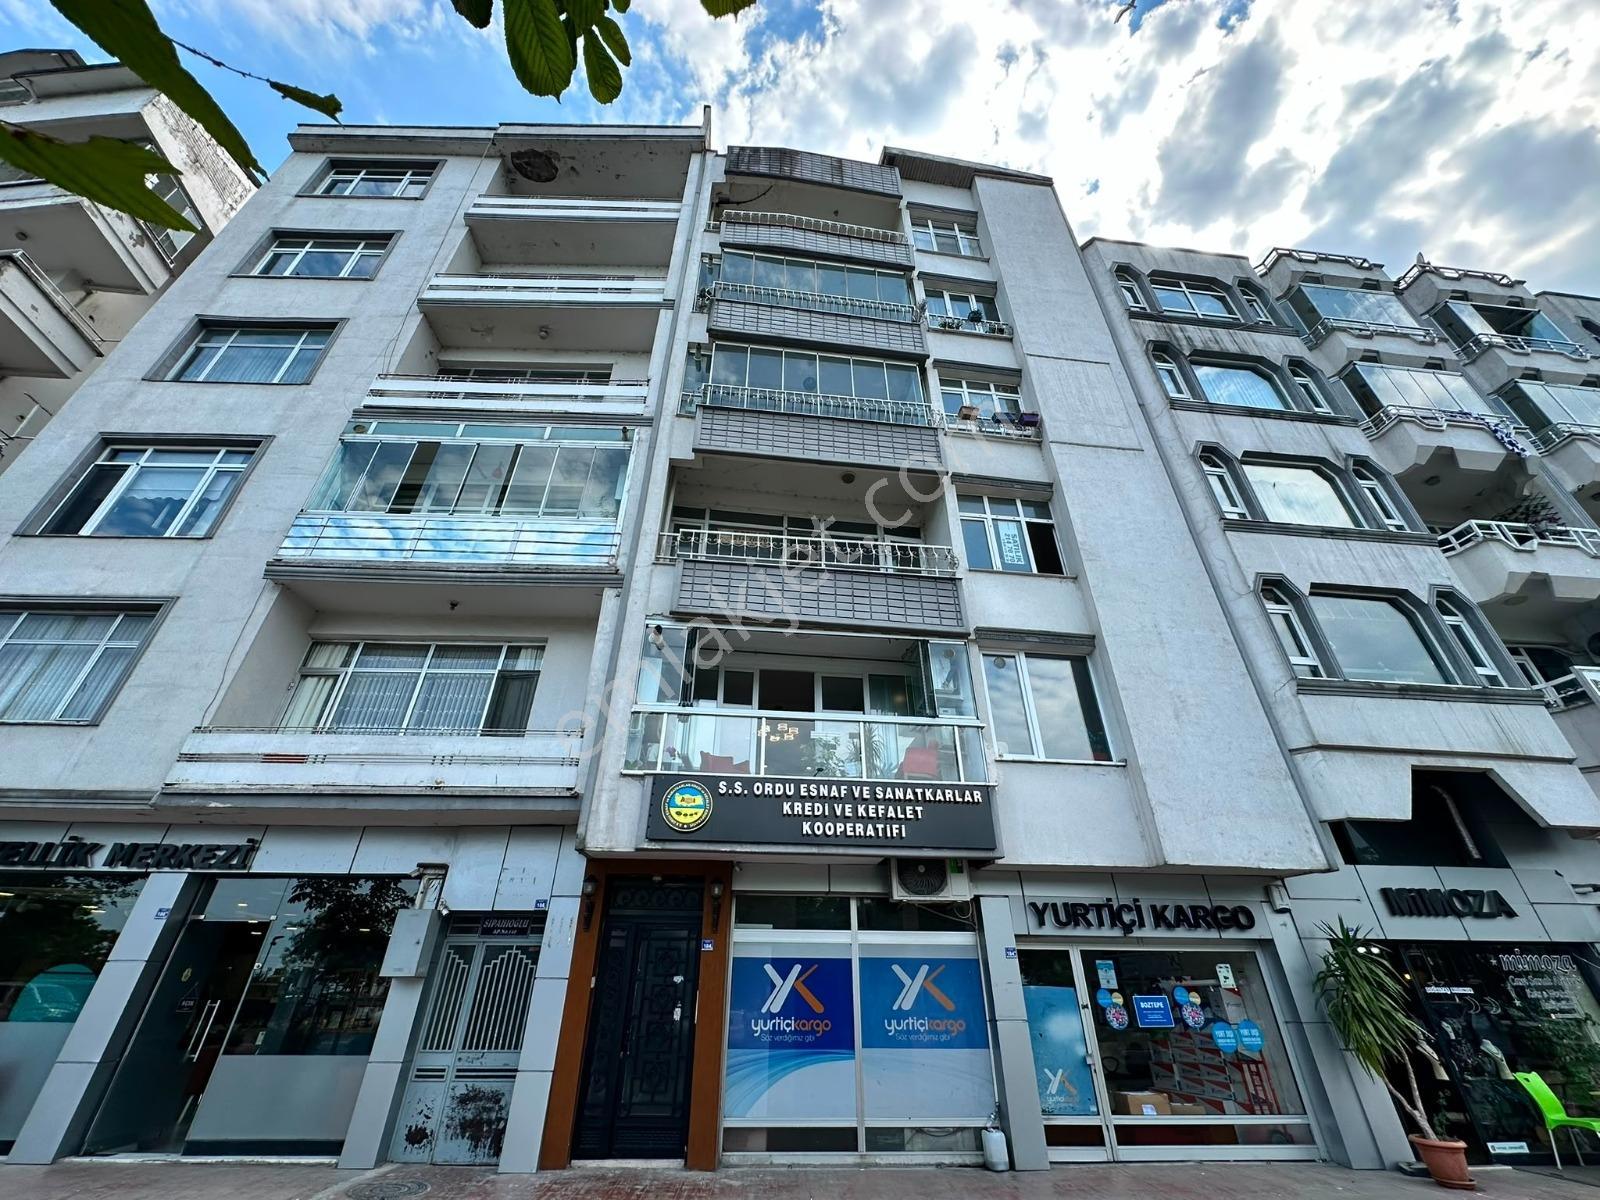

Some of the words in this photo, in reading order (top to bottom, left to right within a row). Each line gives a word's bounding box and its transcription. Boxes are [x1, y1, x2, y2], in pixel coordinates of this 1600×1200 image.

[718, 781, 748, 795] S.S.
[753, 782, 795, 796] ORDU
[800, 784, 848, 798] ESNAF
[852, 785, 871, 799] VE
[875, 786, 983, 803] SANATKARLAR
[833, 803, 853, 817] VE
[857, 804, 923, 819] KEFALET
[102, 836, 261, 869] MERKEZİ
[1029, 897, 1146, 934] YURTİÇİ
[1150, 904, 1255, 930] KARGO
[1499, 948, 1577, 975] mimoza
